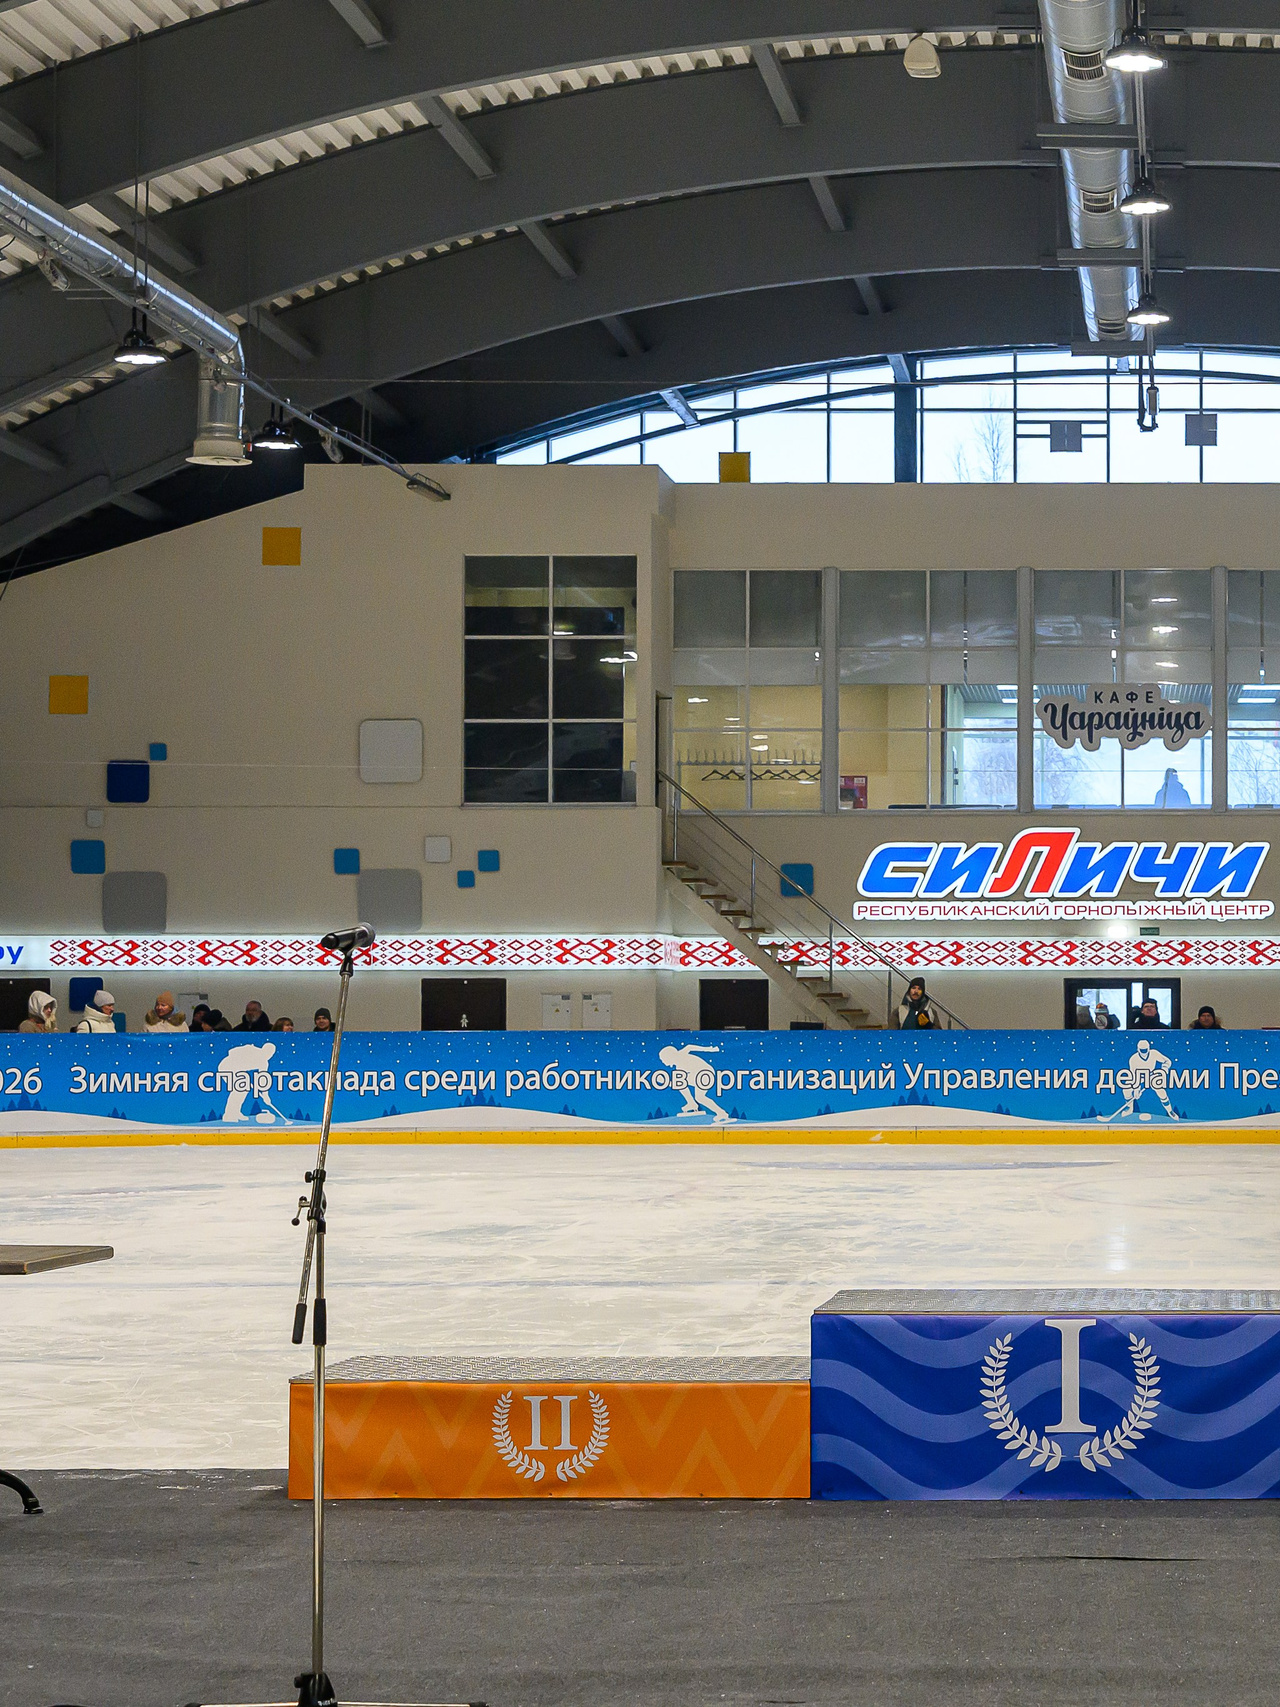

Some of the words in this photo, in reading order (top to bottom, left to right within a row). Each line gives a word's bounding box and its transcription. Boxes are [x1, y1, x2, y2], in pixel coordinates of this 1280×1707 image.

[1094, 691, 1154, 704] КАФЕ
[1044, 703, 1205, 744] Чараўніца
[857, 903, 1048, 916] РЕСПУБЛИКАНСКИЙ
[1054, 903, 1205, 916] ГОРНОЛЫЖНЫЙ
[1211, 906, 1271, 920] ЦЕНТР
[0, 1067, 43, 1094] 26
[69, 1066, 189, 1093] Зимняя
[404, 1068, 497, 1098] среди
[505, 1061, 690, 1098] работников
[696, 1062, 896, 1097] организаций
[903, 1062, 1088, 1096] Управления
[1096, 1068, 1210, 1094] делами
[523, 1395, 578, 1450] II
